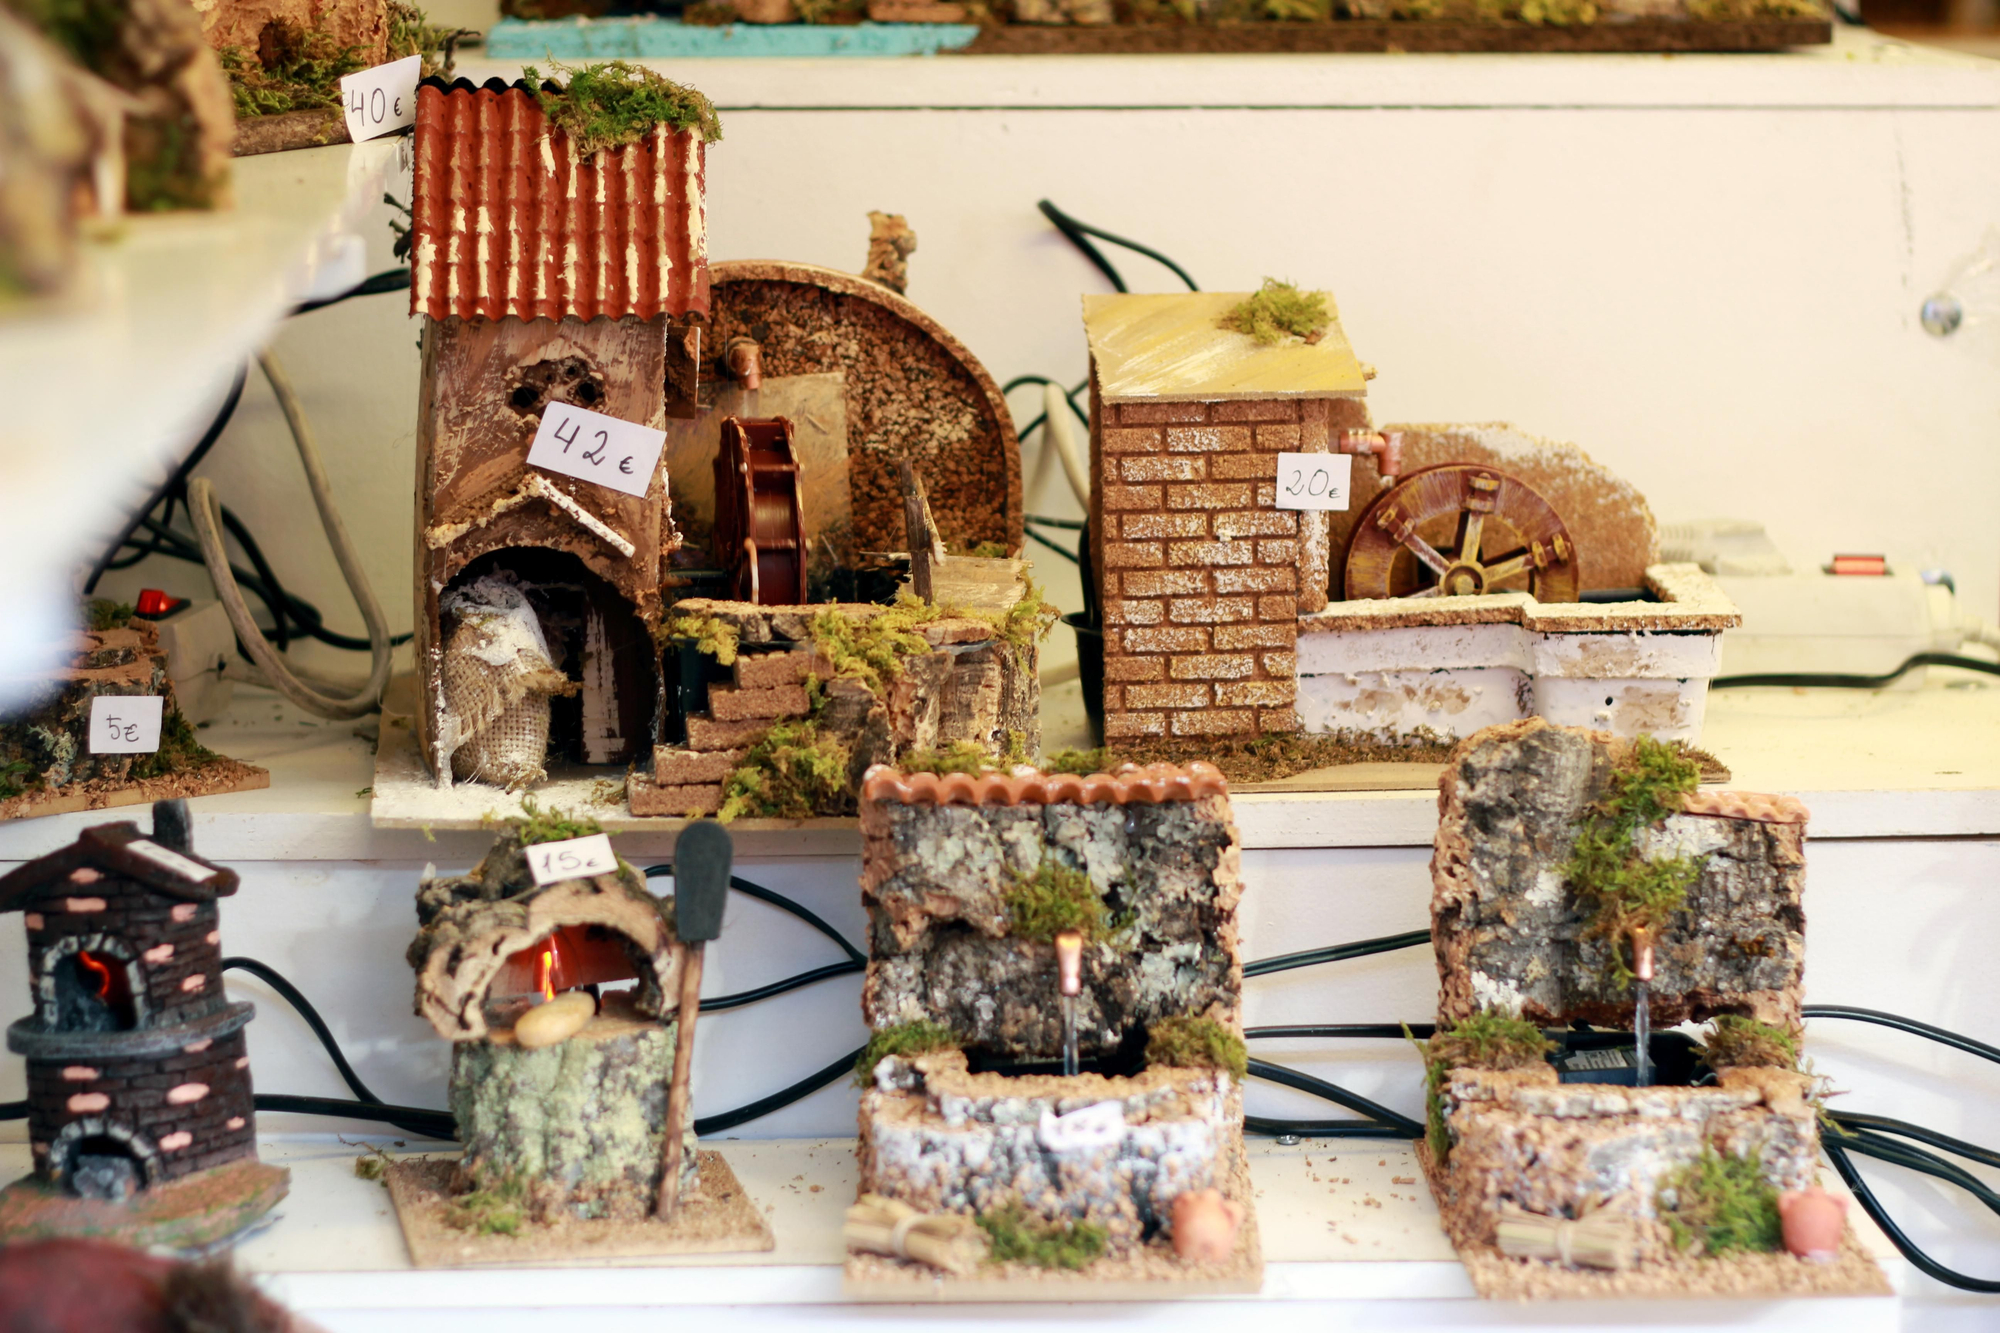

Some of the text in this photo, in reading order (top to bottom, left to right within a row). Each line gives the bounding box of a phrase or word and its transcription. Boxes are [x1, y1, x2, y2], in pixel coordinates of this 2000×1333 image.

[351, 87, 403, 127] 40€
[553, 417, 634, 475] 42€
[1285, 468, 1341, 499] 20€
[106, 714, 139, 743] 5€
[542, 850, 601, 874] 15€
